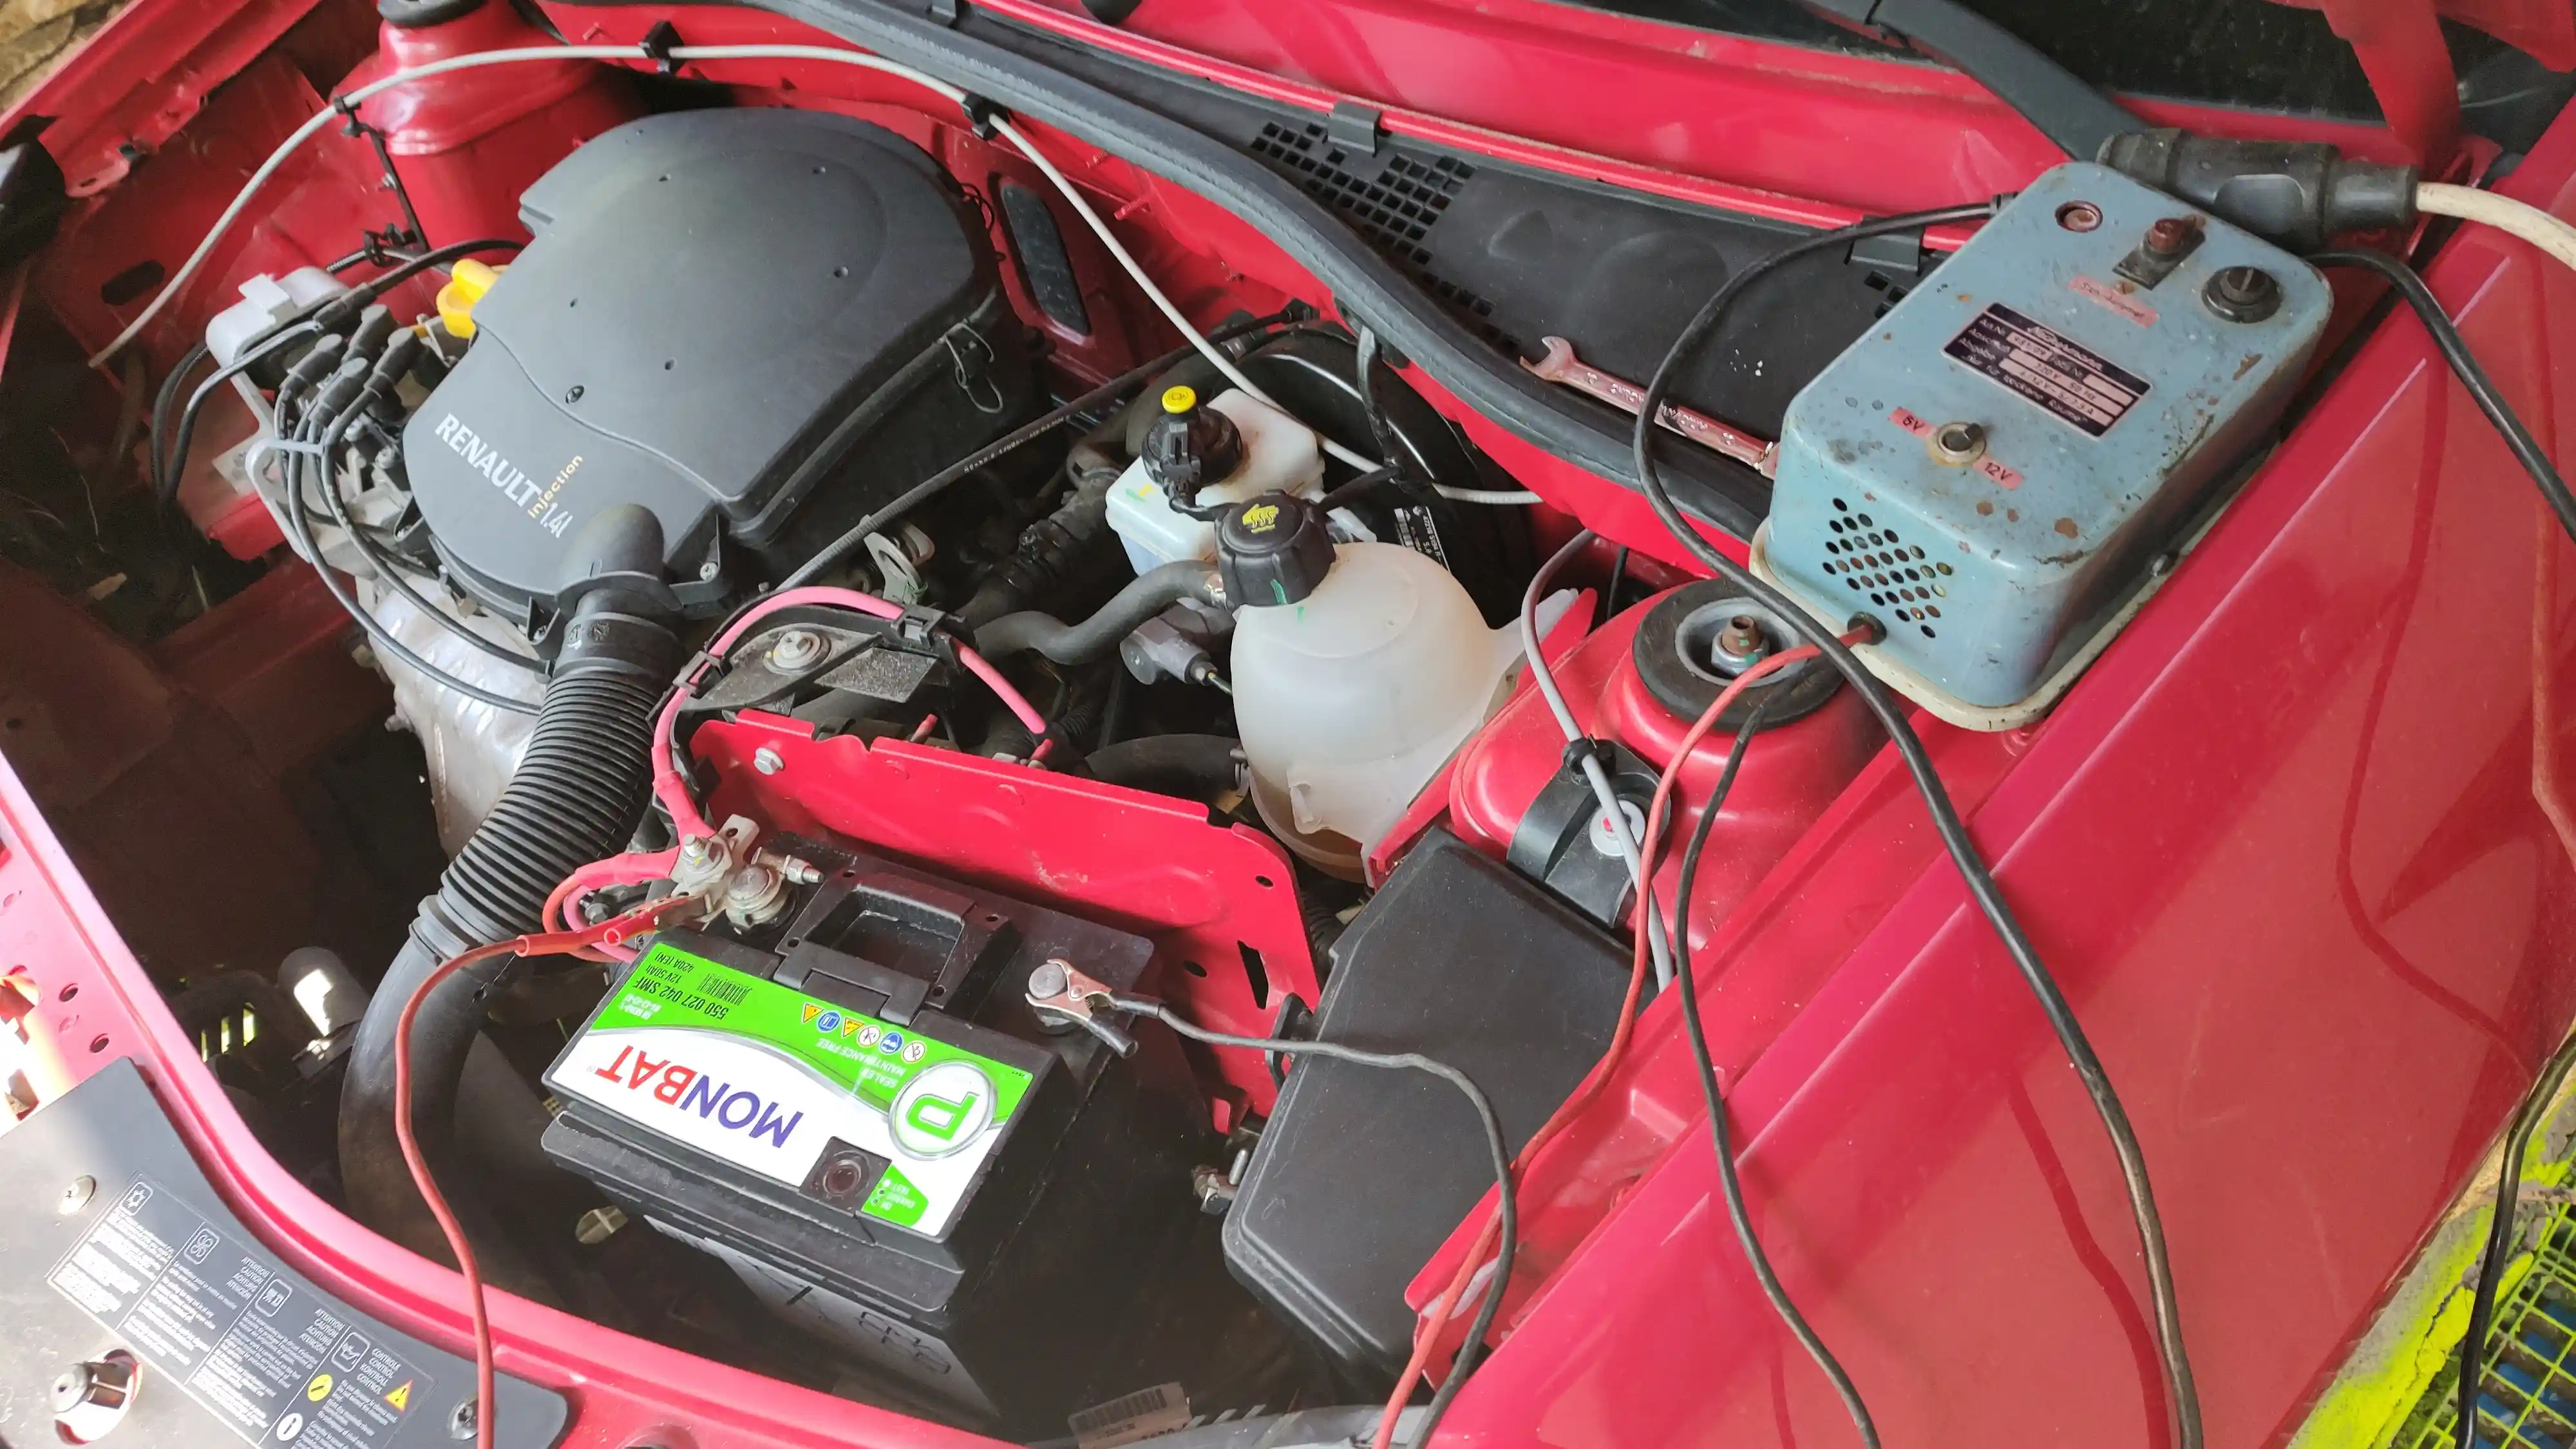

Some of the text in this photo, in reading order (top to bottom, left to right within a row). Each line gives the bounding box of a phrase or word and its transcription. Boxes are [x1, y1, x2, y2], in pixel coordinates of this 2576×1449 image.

[435, 412, 542, 508] RENAULT
[527, 454, 583, 519] injection
[654, 952, 695, 973] 420A (EN)
[632, 977, 661, 994] SMF
[665, 973, 683, 983] 12V
[659, 985, 683, 1003] 042
[681, 994, 705, 1011] 027
[705, 1002, 729, 1020] 550
[814, 1037, 907, 1077] MAINTENANCE FREE
[596, 1045, 804, 1148] MONBAT
[905, 1092, 978, 1140] P
[240, 1266, 263, 1284] CAUTION
[313, 1318, 337, 1337] CAUTION
[359, 1363, 388, 1385] KONTROLL
[368, 1357, 394, 1378] CONTROL
[355, 1374, 383, 1394] CONTROL
